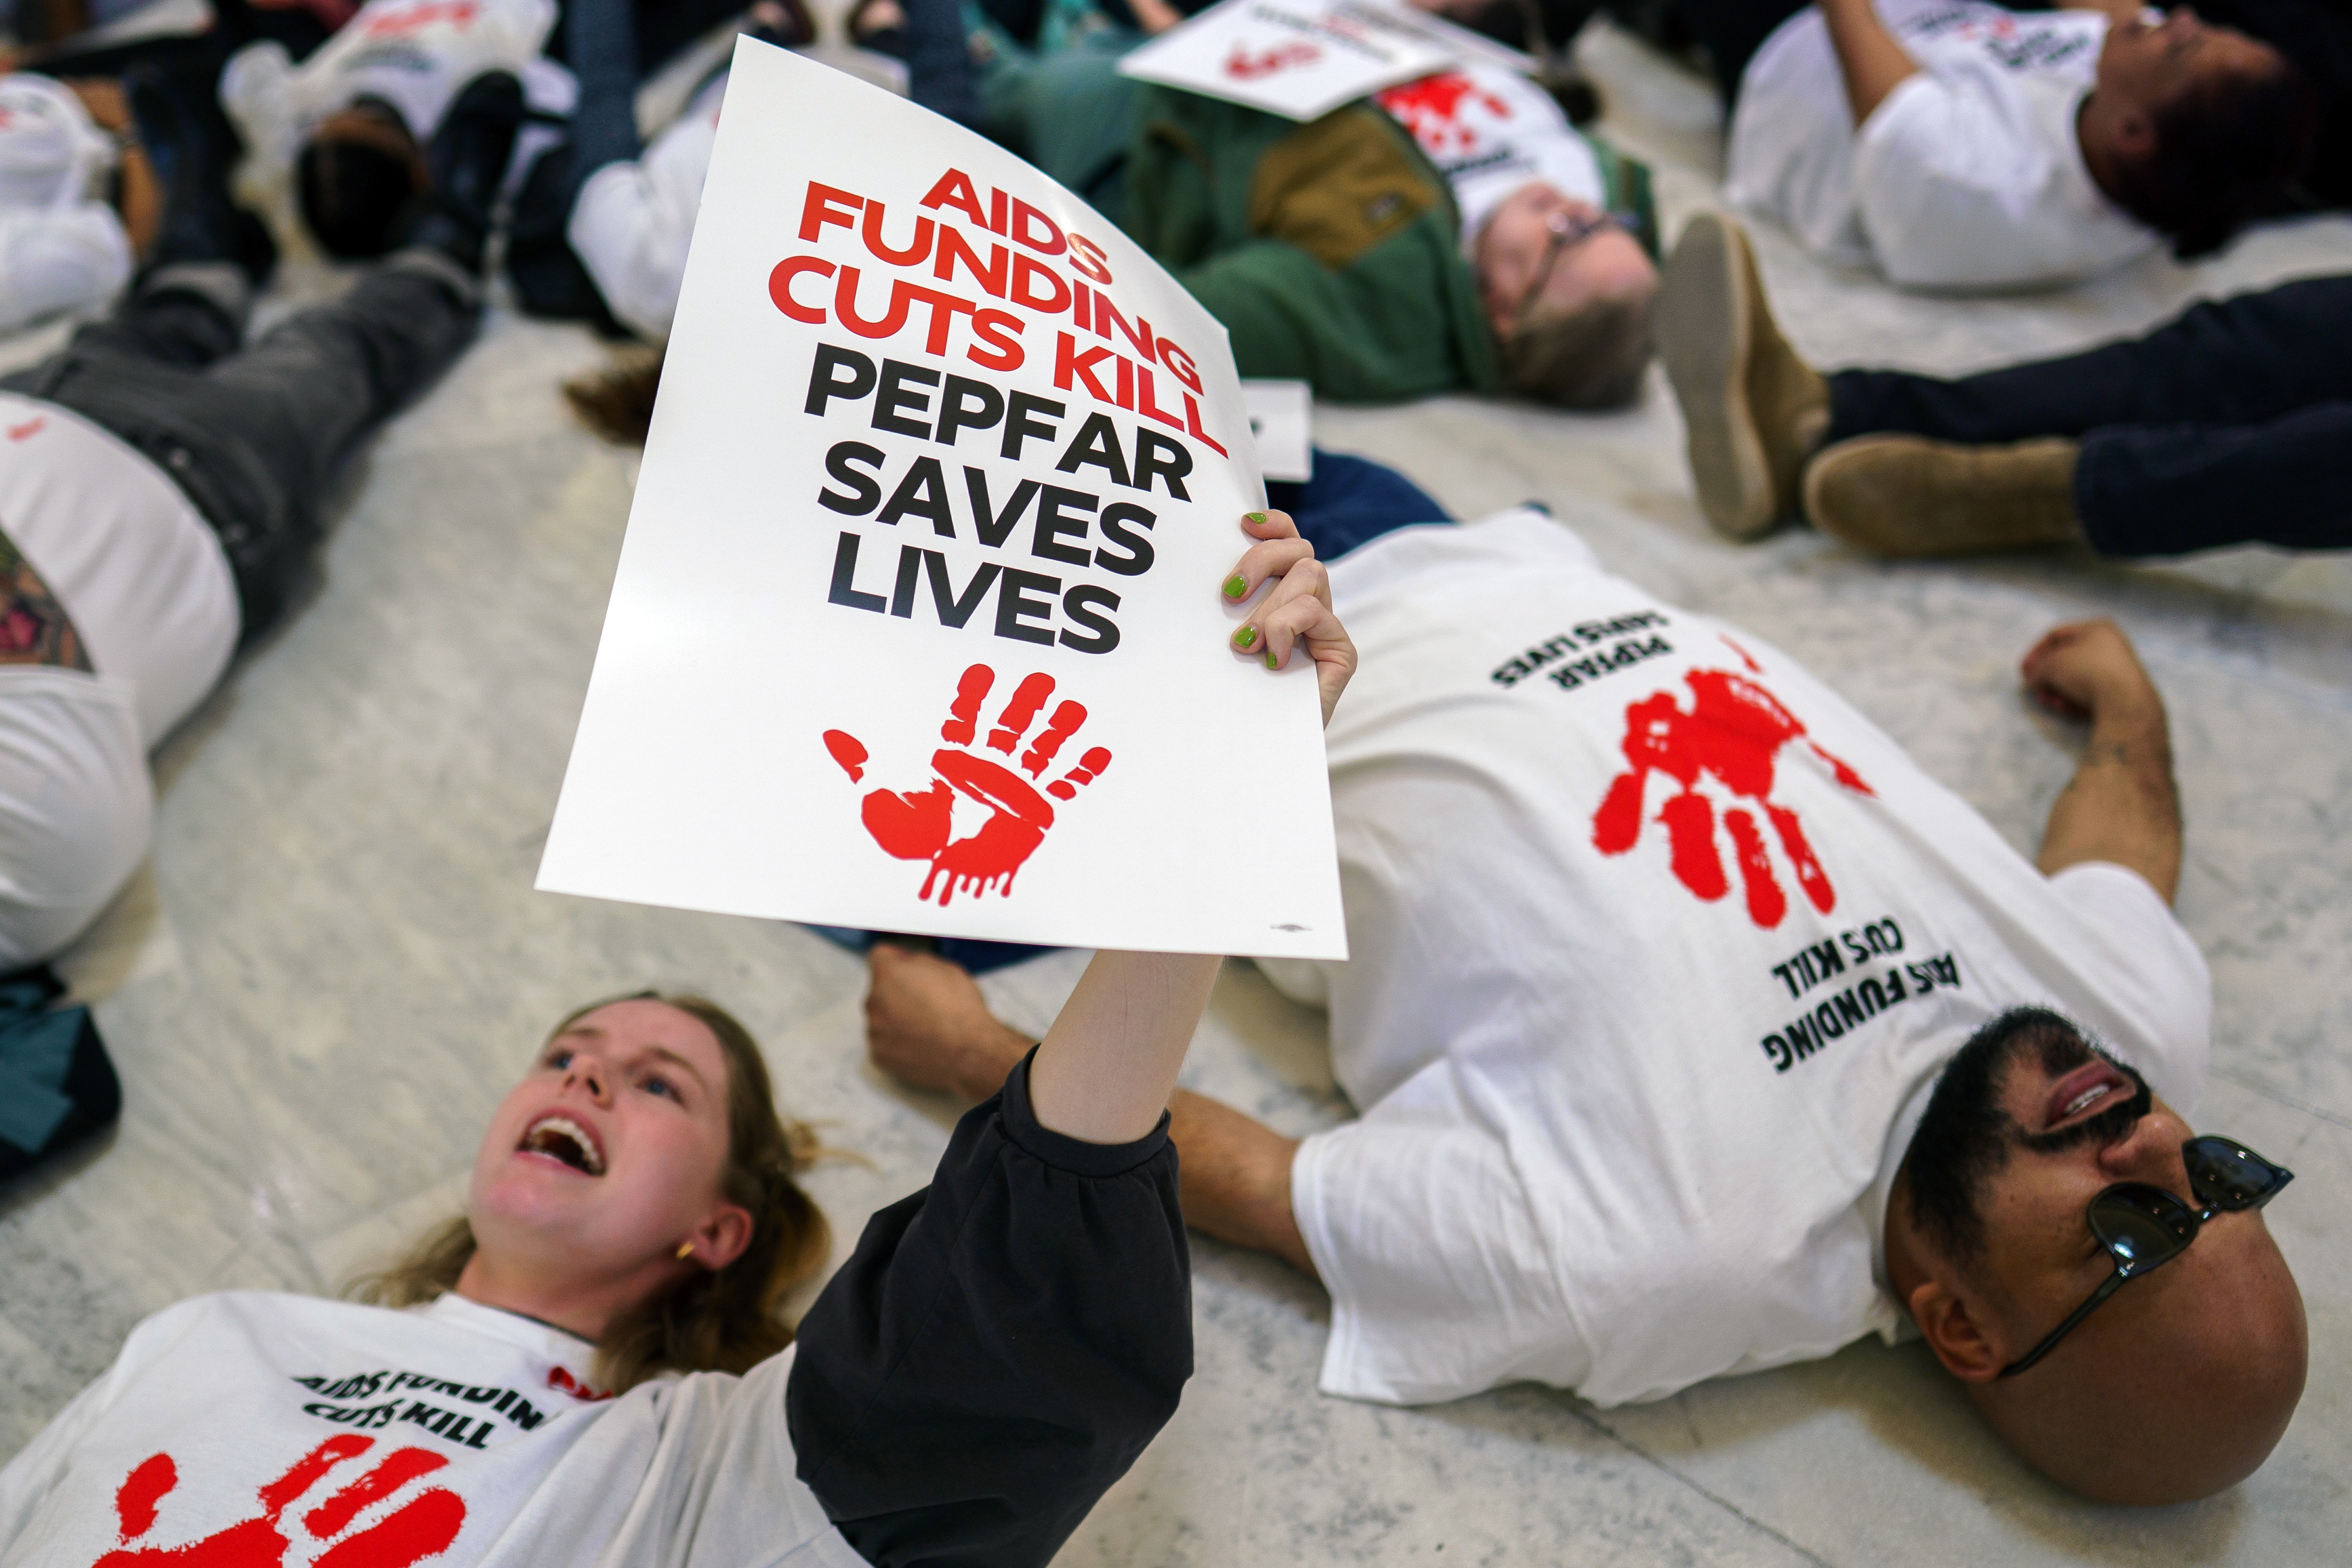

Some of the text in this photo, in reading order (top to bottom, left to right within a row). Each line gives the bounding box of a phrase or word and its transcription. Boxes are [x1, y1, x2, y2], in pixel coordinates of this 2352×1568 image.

[919, 168, 1113, 285] AIDS
[798, 181, 1204, 395] FUNDING
[769, 255, 1229, 459] CUTS KILL
[804, 343, 1193, 503] PEPFAR
[817, 441, 1157, 576] SAVES
[828, 531, 1121, 654] LIVES
[1491, 637, 1579, 690] LIVES
[1771, 918, 1905, 999] CUS KILL
[1761, 969, 1909, 1073] FUNDING
[292, 1370, 546, 1432] AIDS FUNDIN
[302, 1398, 495, 1450] CUTS KILL
